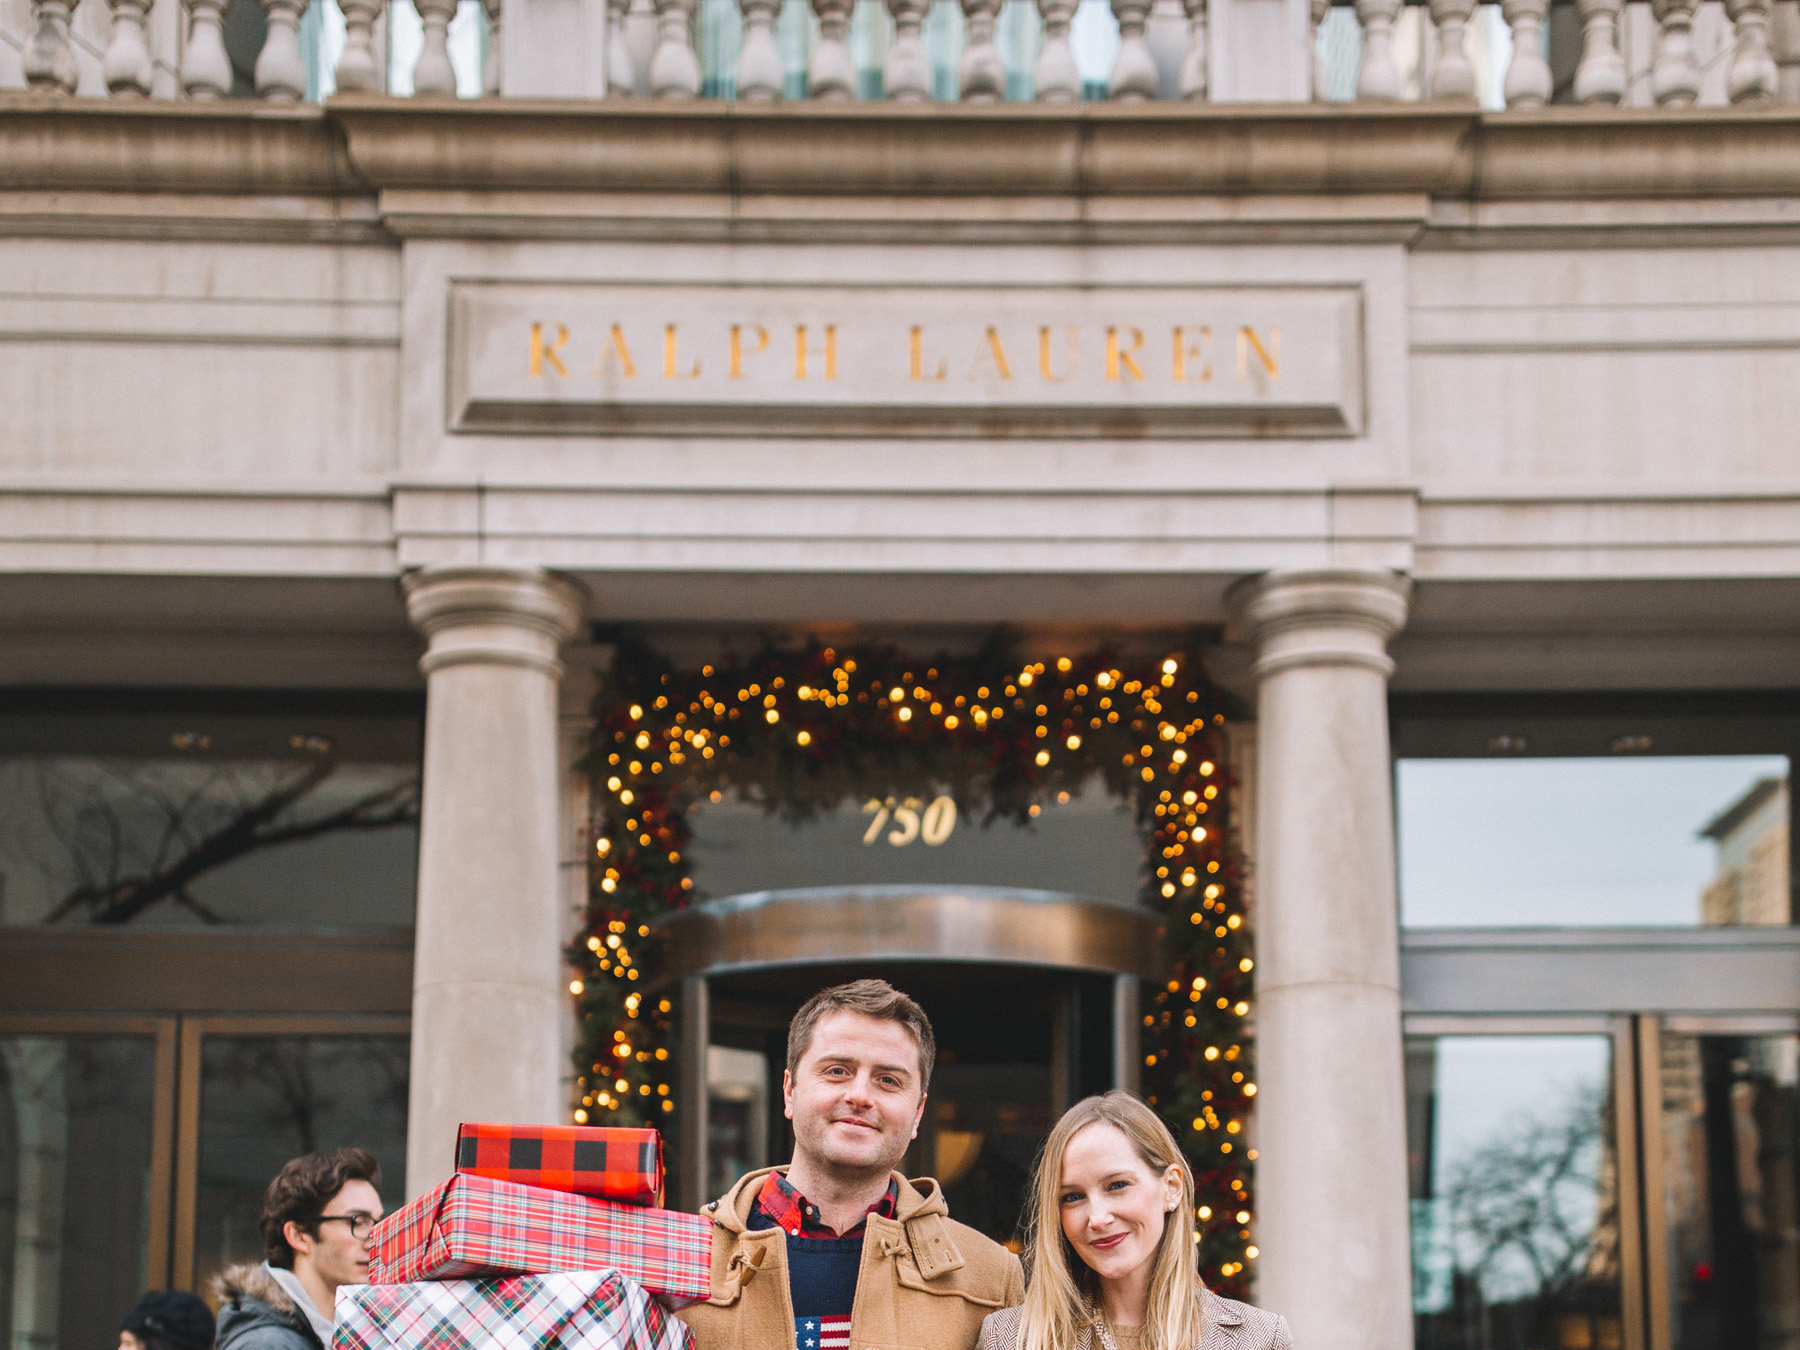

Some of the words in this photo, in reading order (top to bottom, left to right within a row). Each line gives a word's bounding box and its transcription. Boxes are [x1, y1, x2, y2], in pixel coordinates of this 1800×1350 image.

[527, 322, 838, 380] RALPH
[910, 325, 1281, 383] LAUREN
[862, 796, 957, 847] 750
